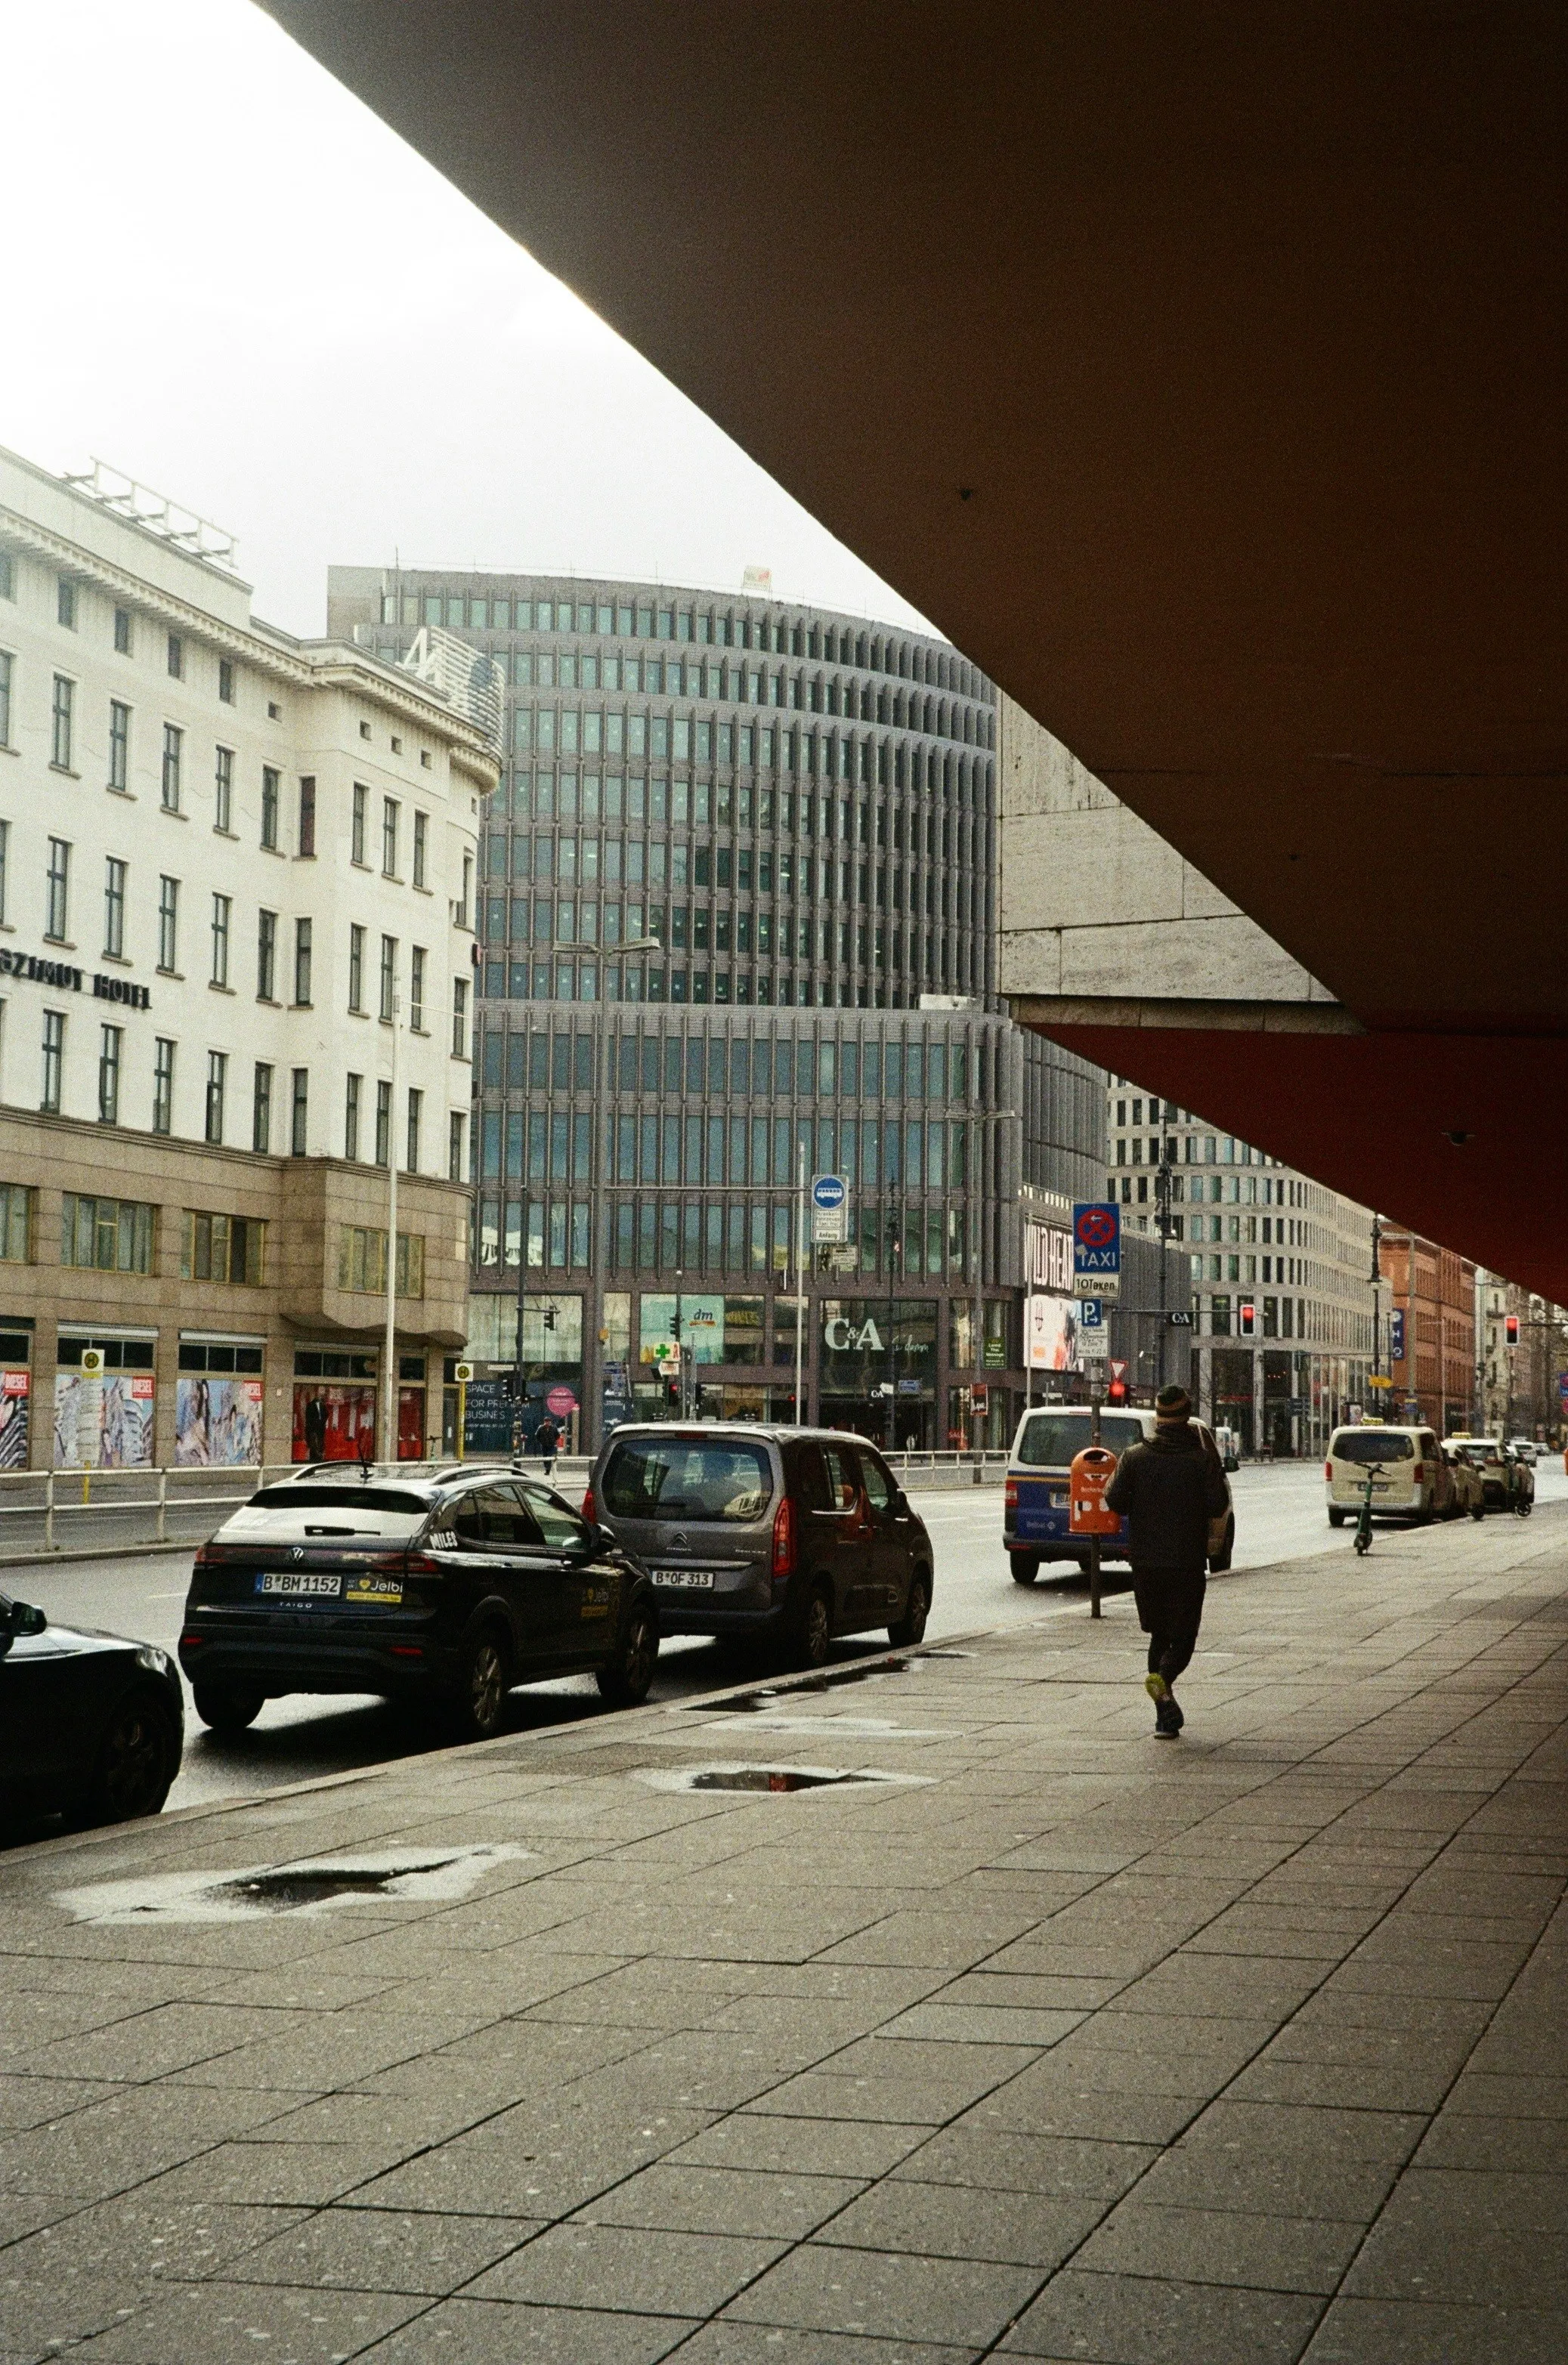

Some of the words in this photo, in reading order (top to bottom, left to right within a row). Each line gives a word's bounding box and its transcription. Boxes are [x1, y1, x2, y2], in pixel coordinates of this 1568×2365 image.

[94, 973, 152, 1009] HOTEL
[1081, 1251, 1115, 1266] TAXI
[694, 1309, 713, 1320] dm
[1084, 1302, 1096, 1324] P
[824, 1318, 885, 1351] C&A
[465, 1384, 495, 1393] SPACE
[465, 1399, 484, 1408] FOR
[429, 1531, 458, 1550] MILES
[264, 1575, 273, 1590] B
[281, 1575, 302, 1591] BM
[303, 1577, 339, 1594] 1152
[656, 1572, 663, 1584] B
[670, 1572, 685, 1584] OF
[687, 1573, 709, 1585] 313
[370, 1580, 404, 1594] Jelbi
